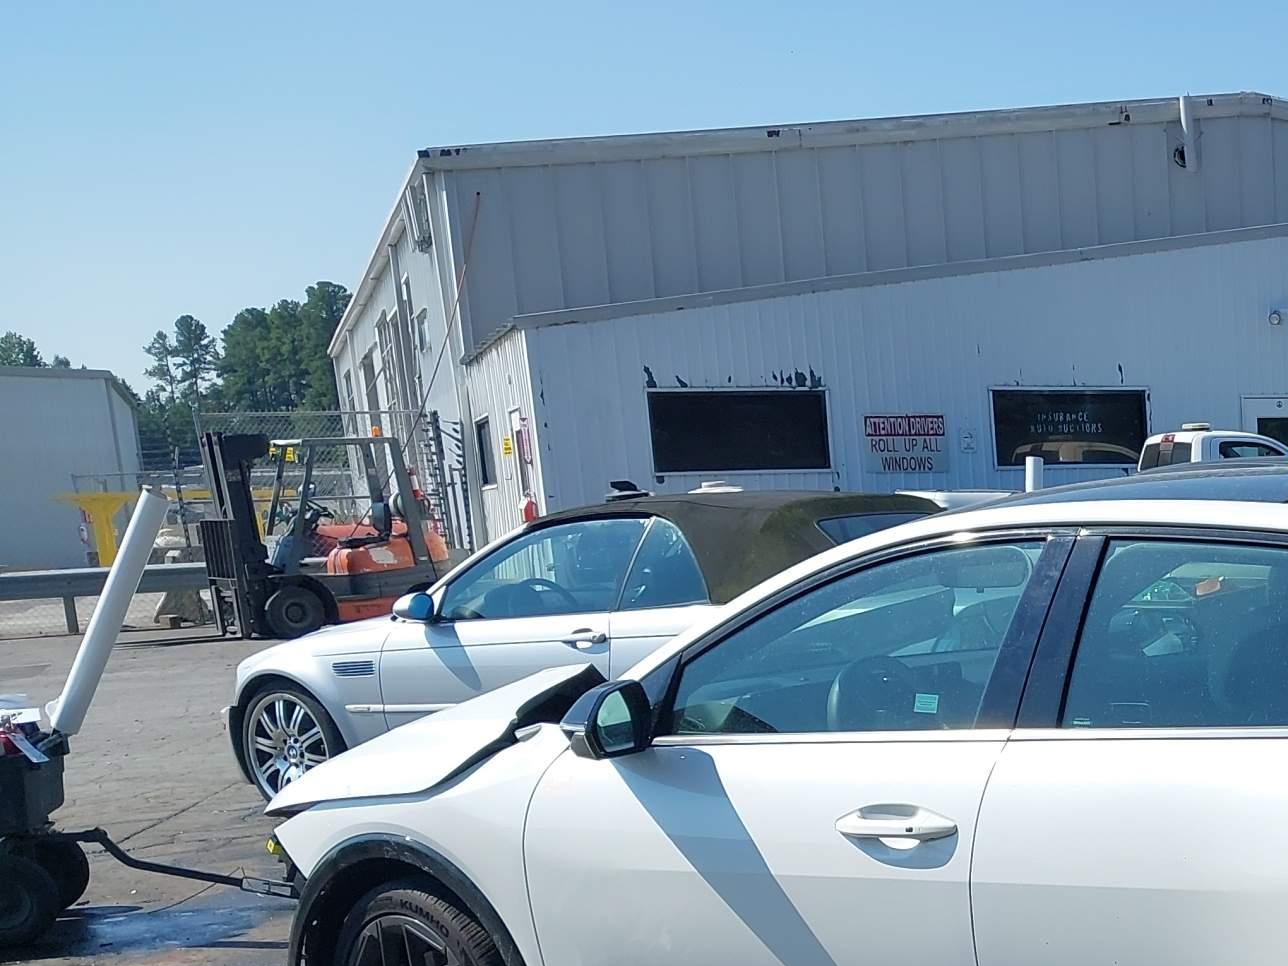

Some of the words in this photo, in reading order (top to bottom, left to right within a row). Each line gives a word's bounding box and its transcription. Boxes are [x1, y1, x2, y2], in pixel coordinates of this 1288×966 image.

[866, 418, 909, 435] ATTENTION
[911, 417, 944, 434] DRIVERS
[871, 438, 899, 453] ROLL
[903, 438, 918, 453] UP
[921, 438, 942, 453] ALL
[881, 456, 934, 472] WINDOWS
[399, 899, 450, 938] KUMHO
